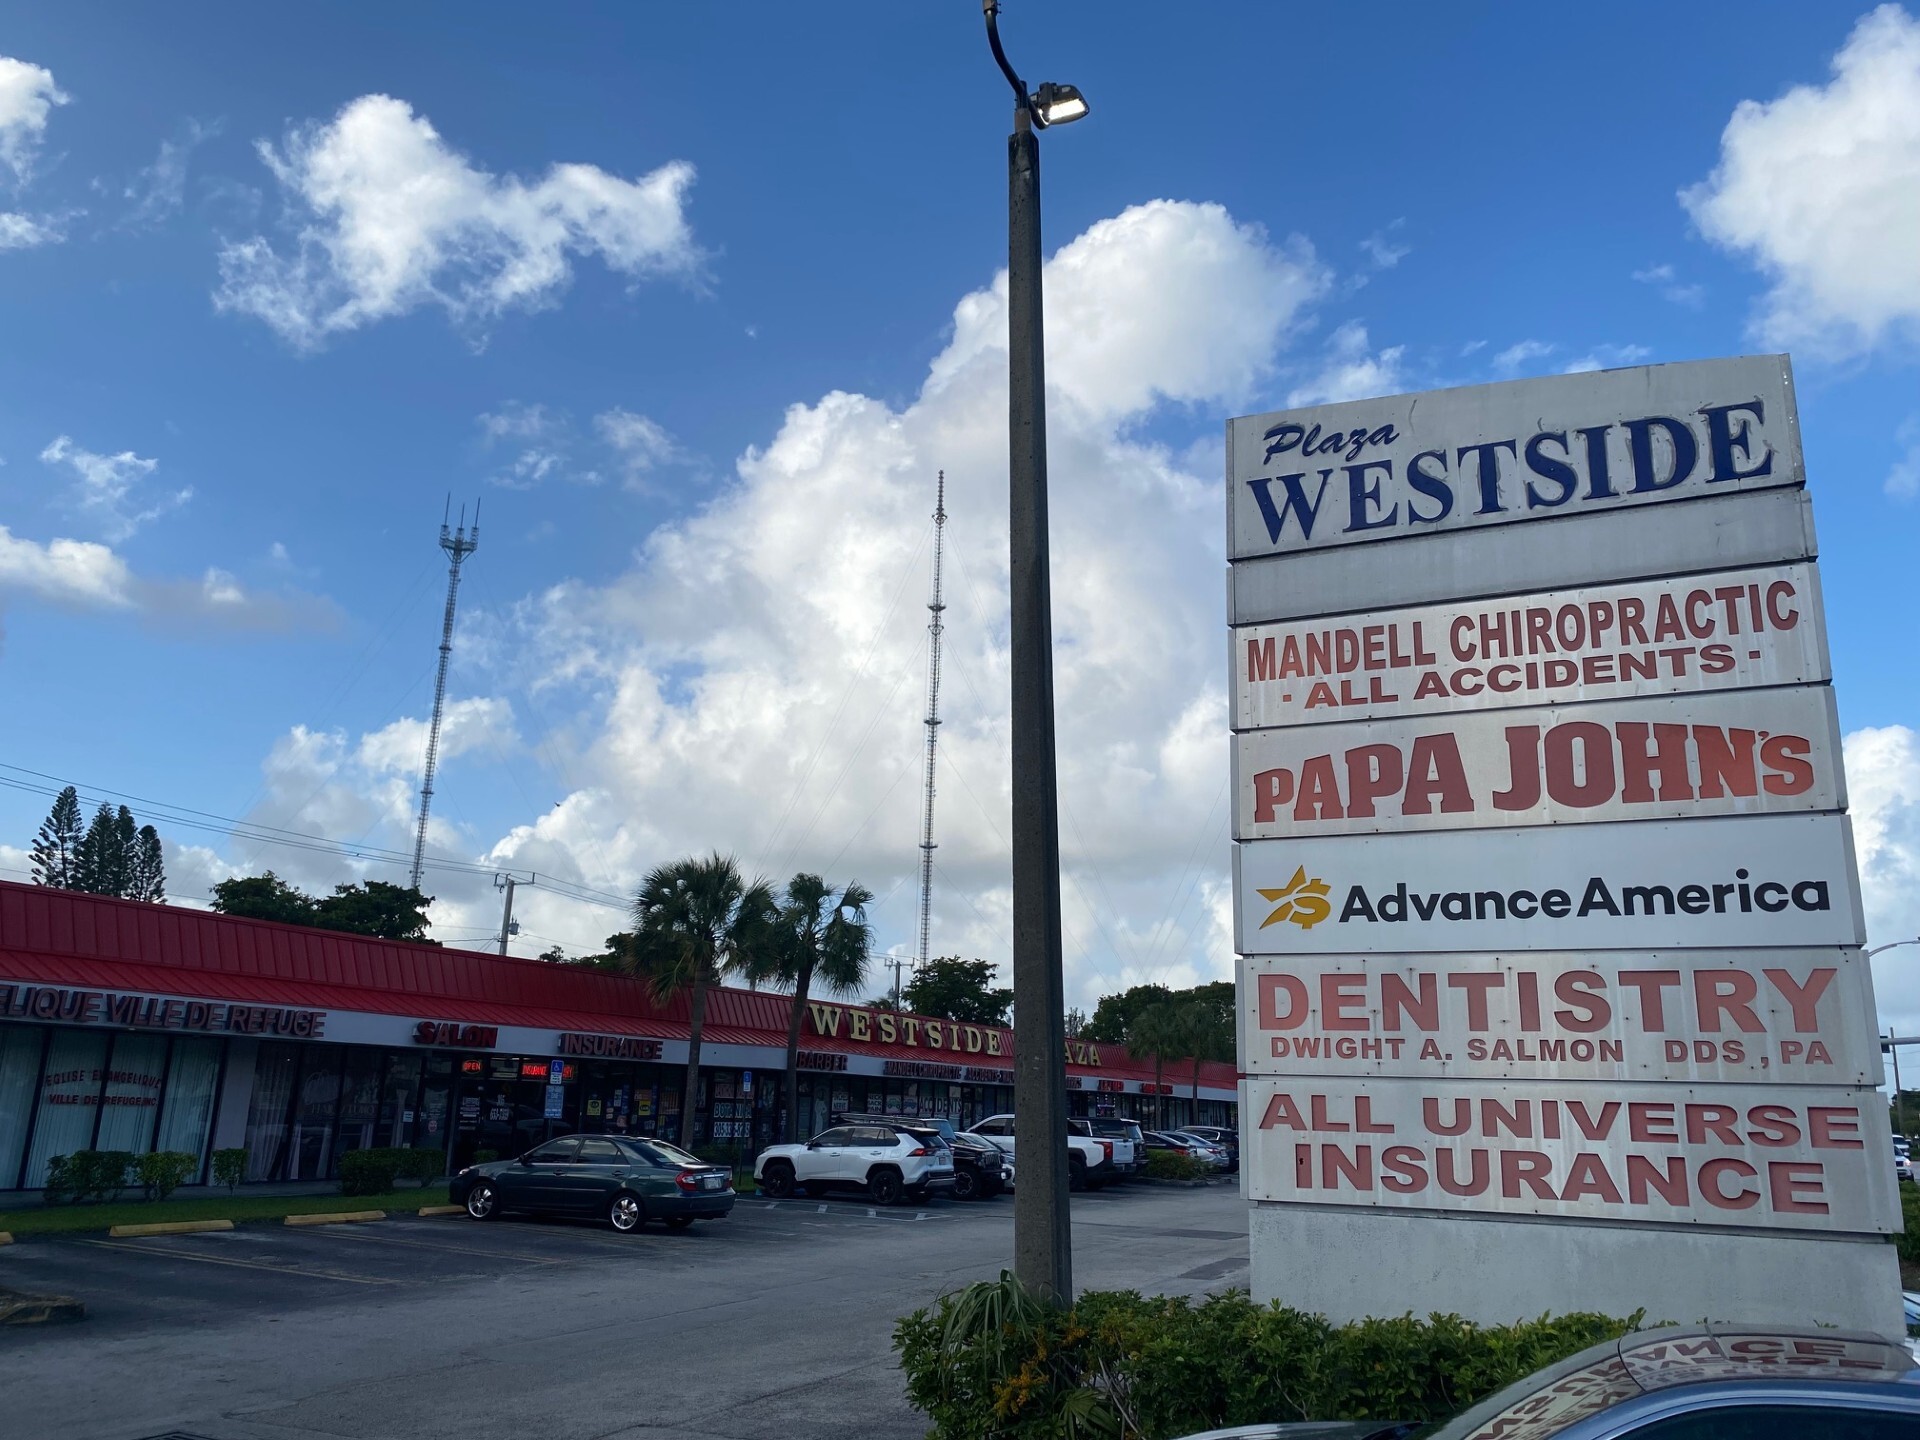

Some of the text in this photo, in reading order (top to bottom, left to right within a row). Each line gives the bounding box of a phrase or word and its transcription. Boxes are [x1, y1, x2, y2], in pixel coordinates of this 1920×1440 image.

[1262, 422, 1400, 465] Plaza
[1246, 400, 1774, 546] WESTSIDE
[1247, 580, 1799, 683] MANDELL CHIROPRACTIC
[1304, 643, 1736, 710] ALL ACCIDENTS
[1253, 721, 1815, 823] PAPA JOHN'S
[106, 993, 185, 1028] VILLE
[185, 1002, 226, 1030] DE
[228, 1004, 327, 1037] REFUGE
[1258, 970, 1838, 1033] DENTISTRY
[414, 1021, 499, 1049] SALON
[561, 1032, 664, 1060] INSURANCE
[808, 1003, 1001, 1056] WESTSIDE
[1270, 1037, 1405, 1060] DWIGHT
[1419, 1039, 1453, 1060] A.
[1467, 1038, 1624, 1063] SALMON
[46, 1070, 85, 1087] EGLISE
[463, 1061, 481, 1071] OPEN
[49, 1094, 79, 1105] VILLE
[84, 1095, 99, 1105] DE
[104, 1097, 141, 1106] REFUGE
[919, 1096, 962, 1113] ACCIDENTS
[1259, 1093, 1864, 1149] ALL UNIVERSE
[1295, 1143, 1830, 1216] INSURANCE
